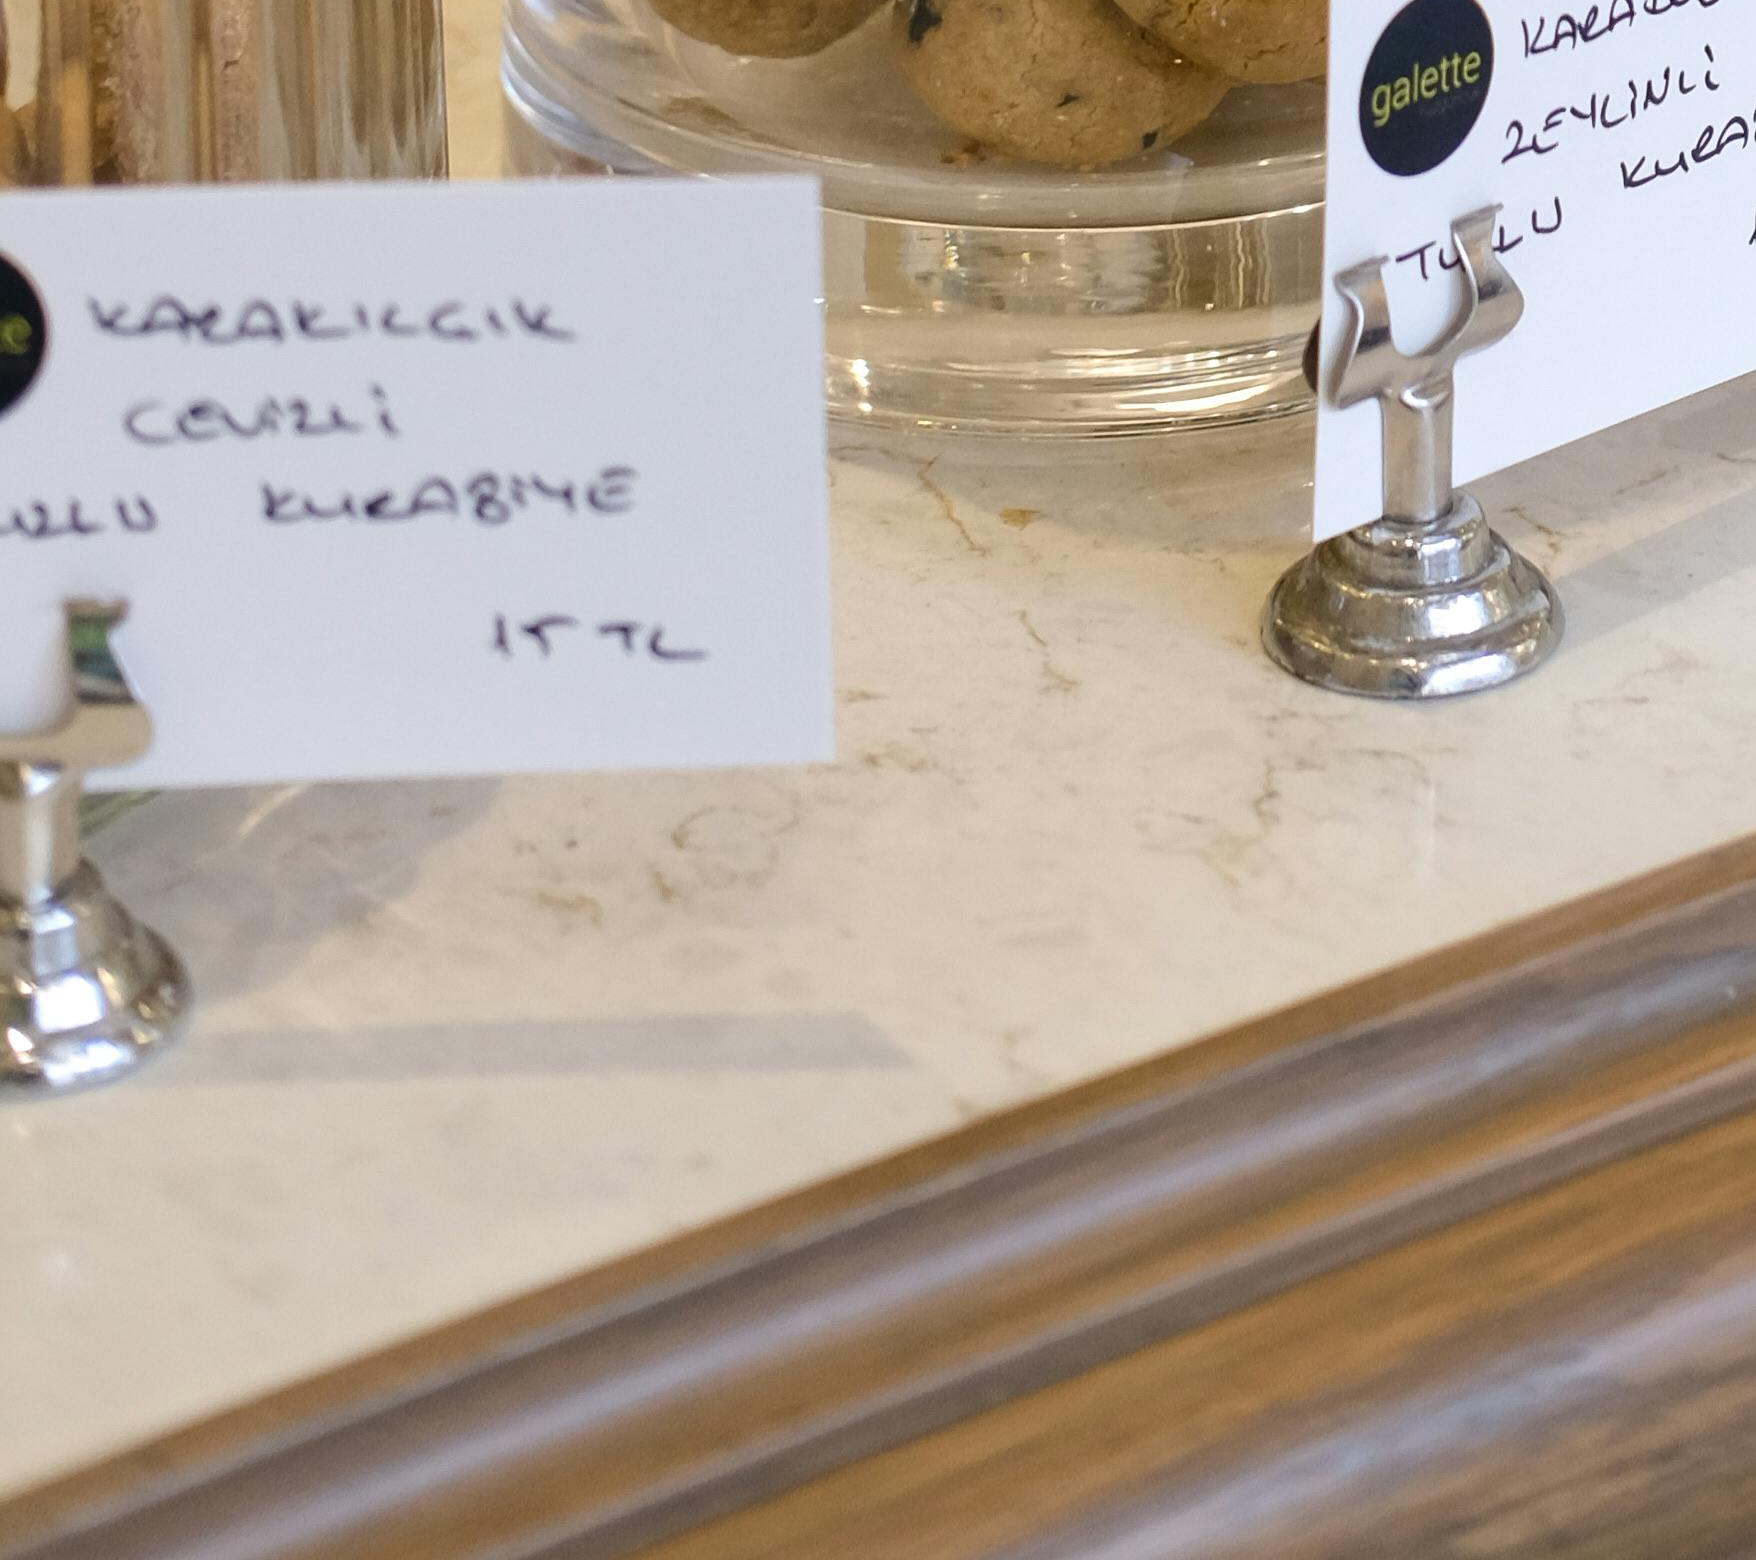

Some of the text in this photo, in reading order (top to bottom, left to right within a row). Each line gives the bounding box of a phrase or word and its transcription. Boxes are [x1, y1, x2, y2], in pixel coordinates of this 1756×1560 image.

[1370, 50, 1482, 128] galette
[1394, 194, 1564, 282] TULU
[489, 610, 709, 665] 15 TL
